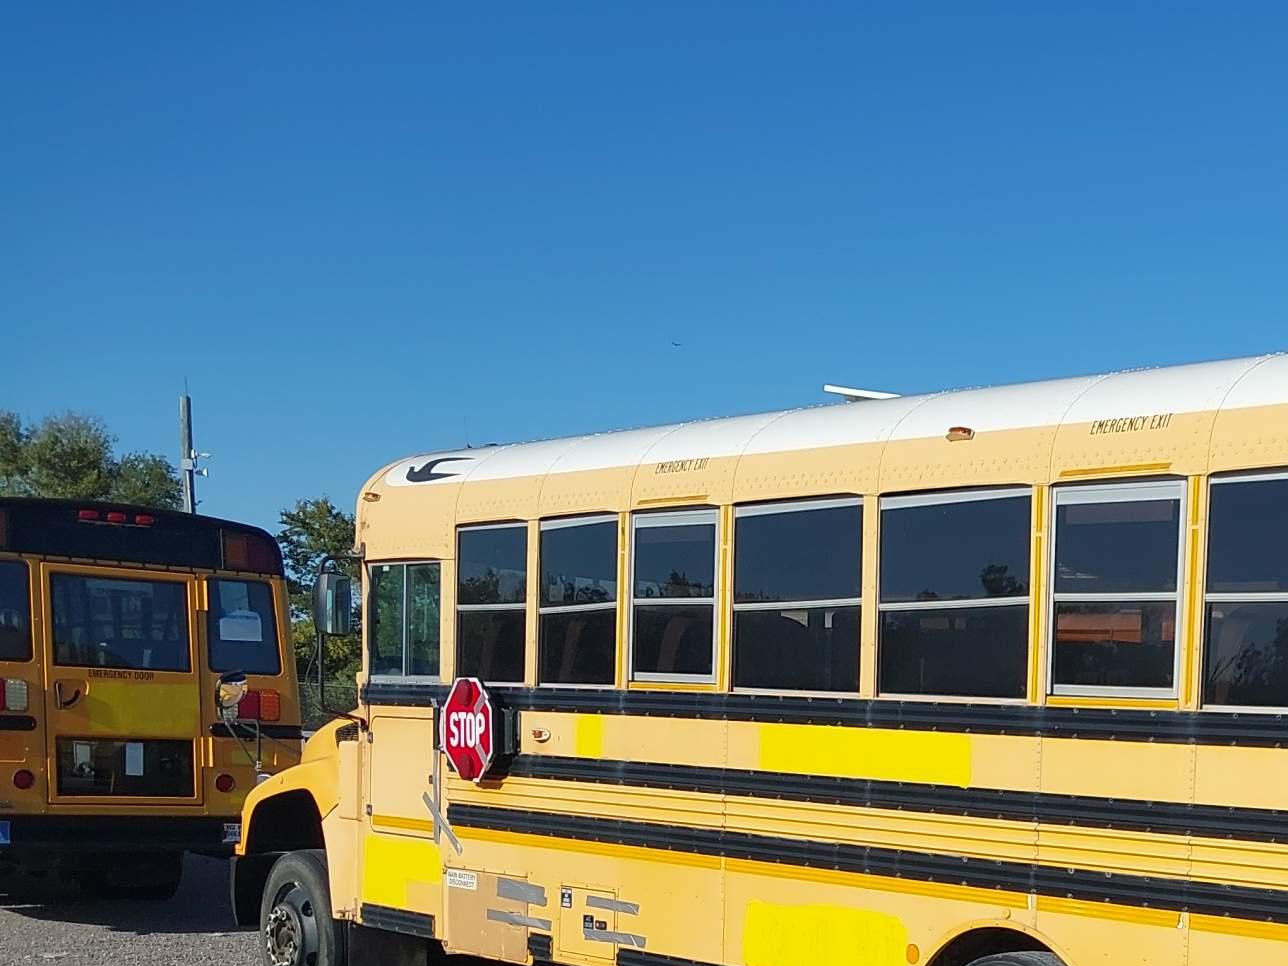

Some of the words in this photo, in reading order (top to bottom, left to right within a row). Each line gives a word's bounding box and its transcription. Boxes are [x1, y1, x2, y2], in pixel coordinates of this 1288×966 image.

[1090, 415, 1149, 435] EMERGENCY
[1150, 413, 1174, 430] EXIT
[655, 459, 694, 474] EMERGENCY
[693, 457, 710, 471] EXIT
[88, 669, 132, 680] EMERGENCY
[134, 671, 154, 681] DOOR
[449, 711, 486, 748] STOP
